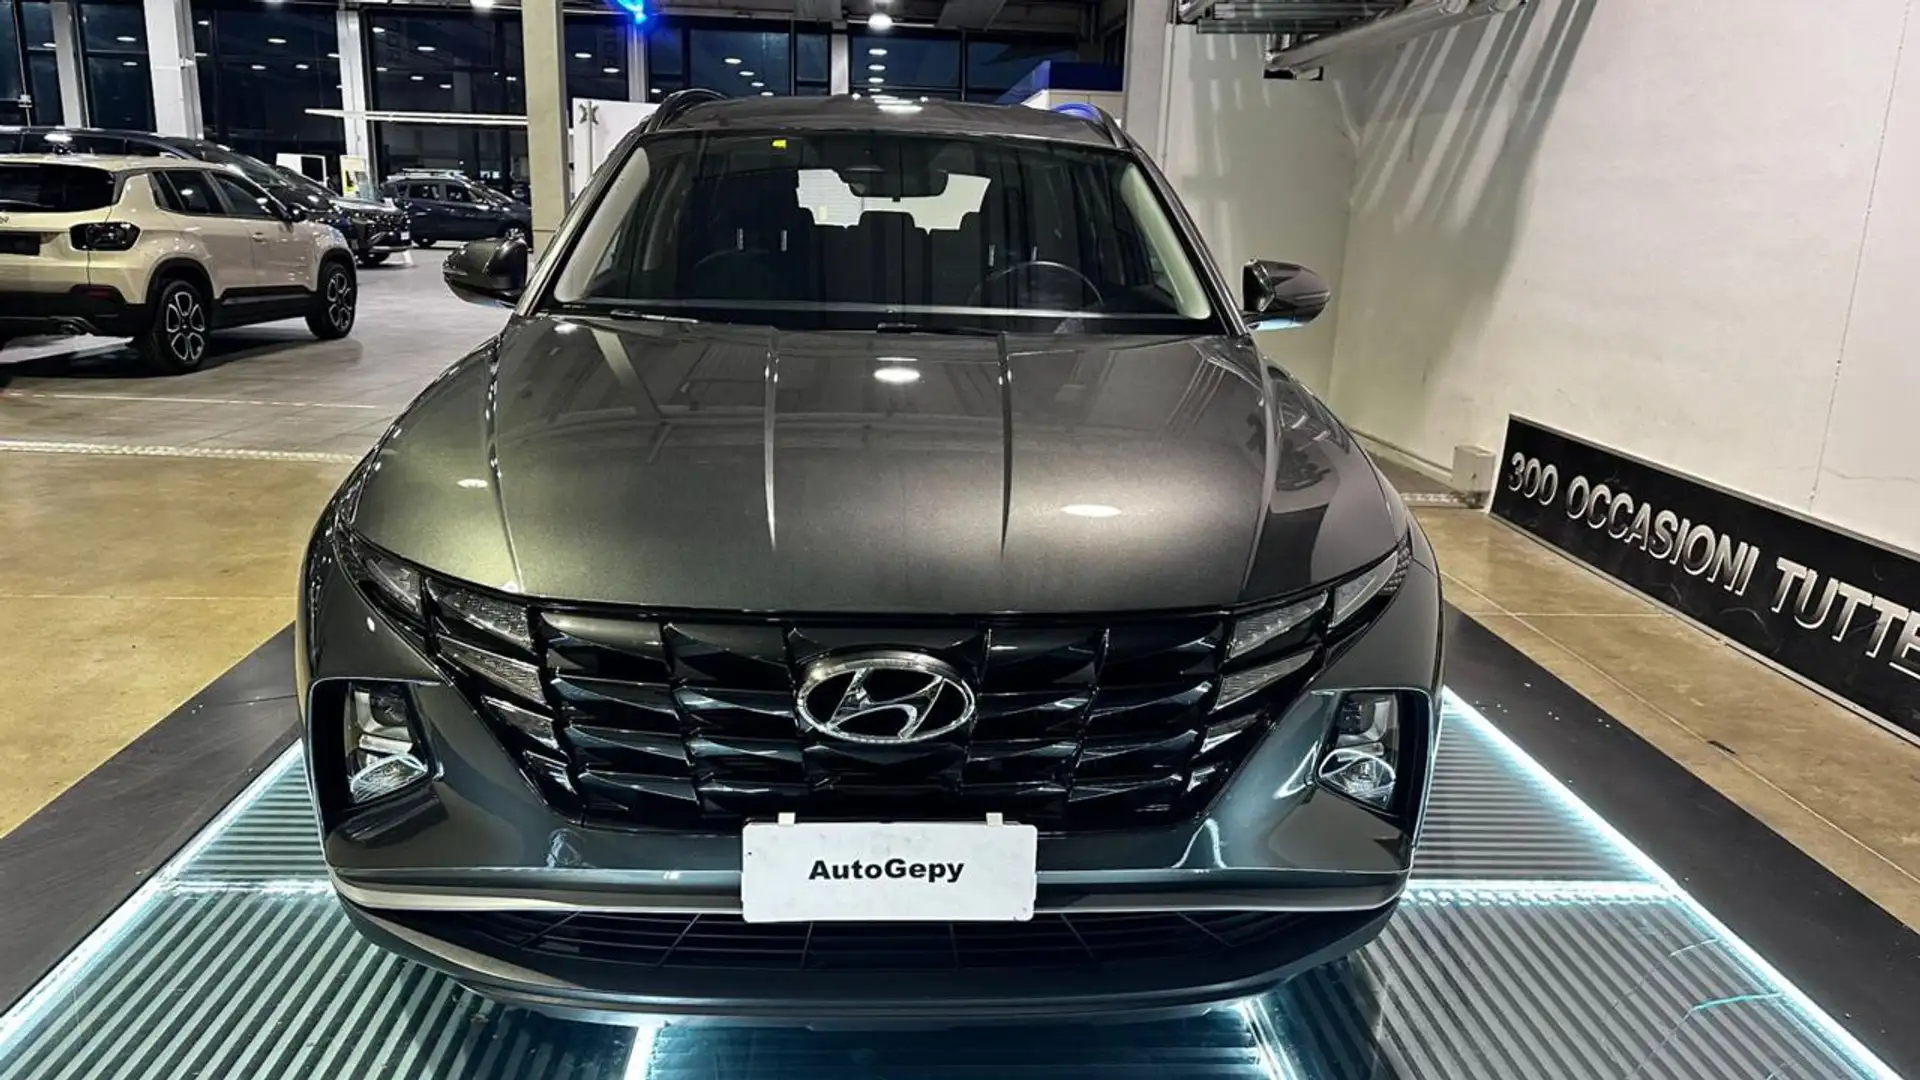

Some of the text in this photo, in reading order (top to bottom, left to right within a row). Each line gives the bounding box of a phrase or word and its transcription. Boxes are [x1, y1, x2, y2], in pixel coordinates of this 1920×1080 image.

[1508, 451, 1558, 506] 300
[1566, 475, 1760, 597] OCCASIONI
[808, 858, 965, 883] AutoGepy
